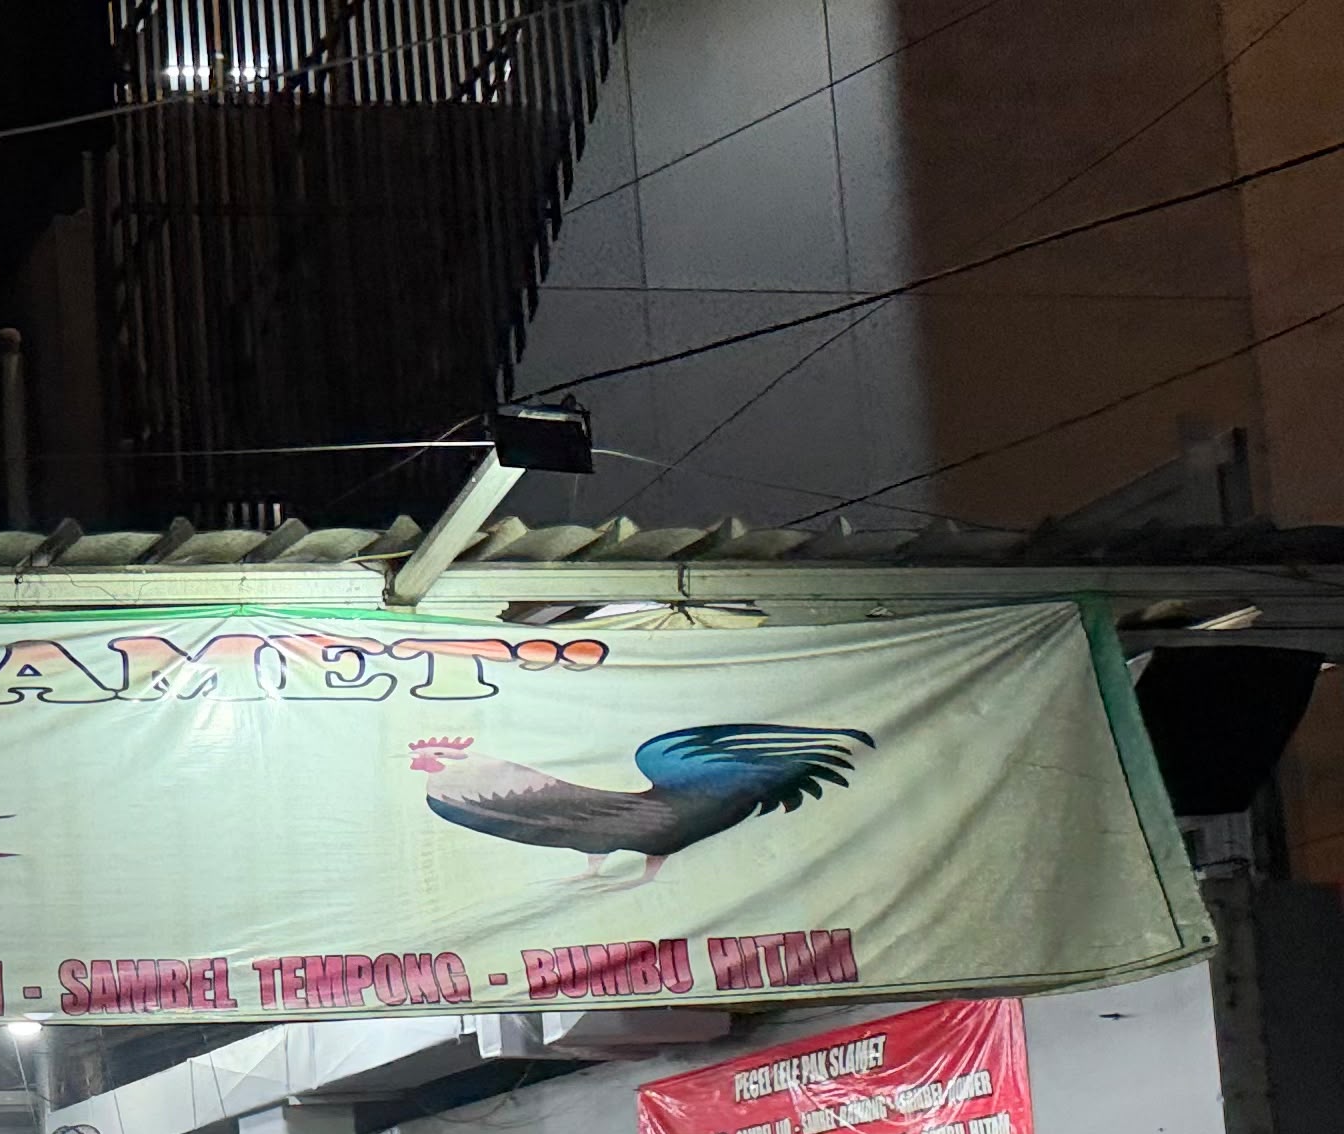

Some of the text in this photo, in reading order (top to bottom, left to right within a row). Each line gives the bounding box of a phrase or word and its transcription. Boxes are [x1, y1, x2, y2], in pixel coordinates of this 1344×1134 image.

[59, 956, 238, 1017] SAMBEL
[252, 950, 472, 1010] TEMPONG
[522, 938, 694, 1001] BUMBU
[708, 929, 859, 994] HITAM
[829, 1033, 887, 1079] SLAMET
